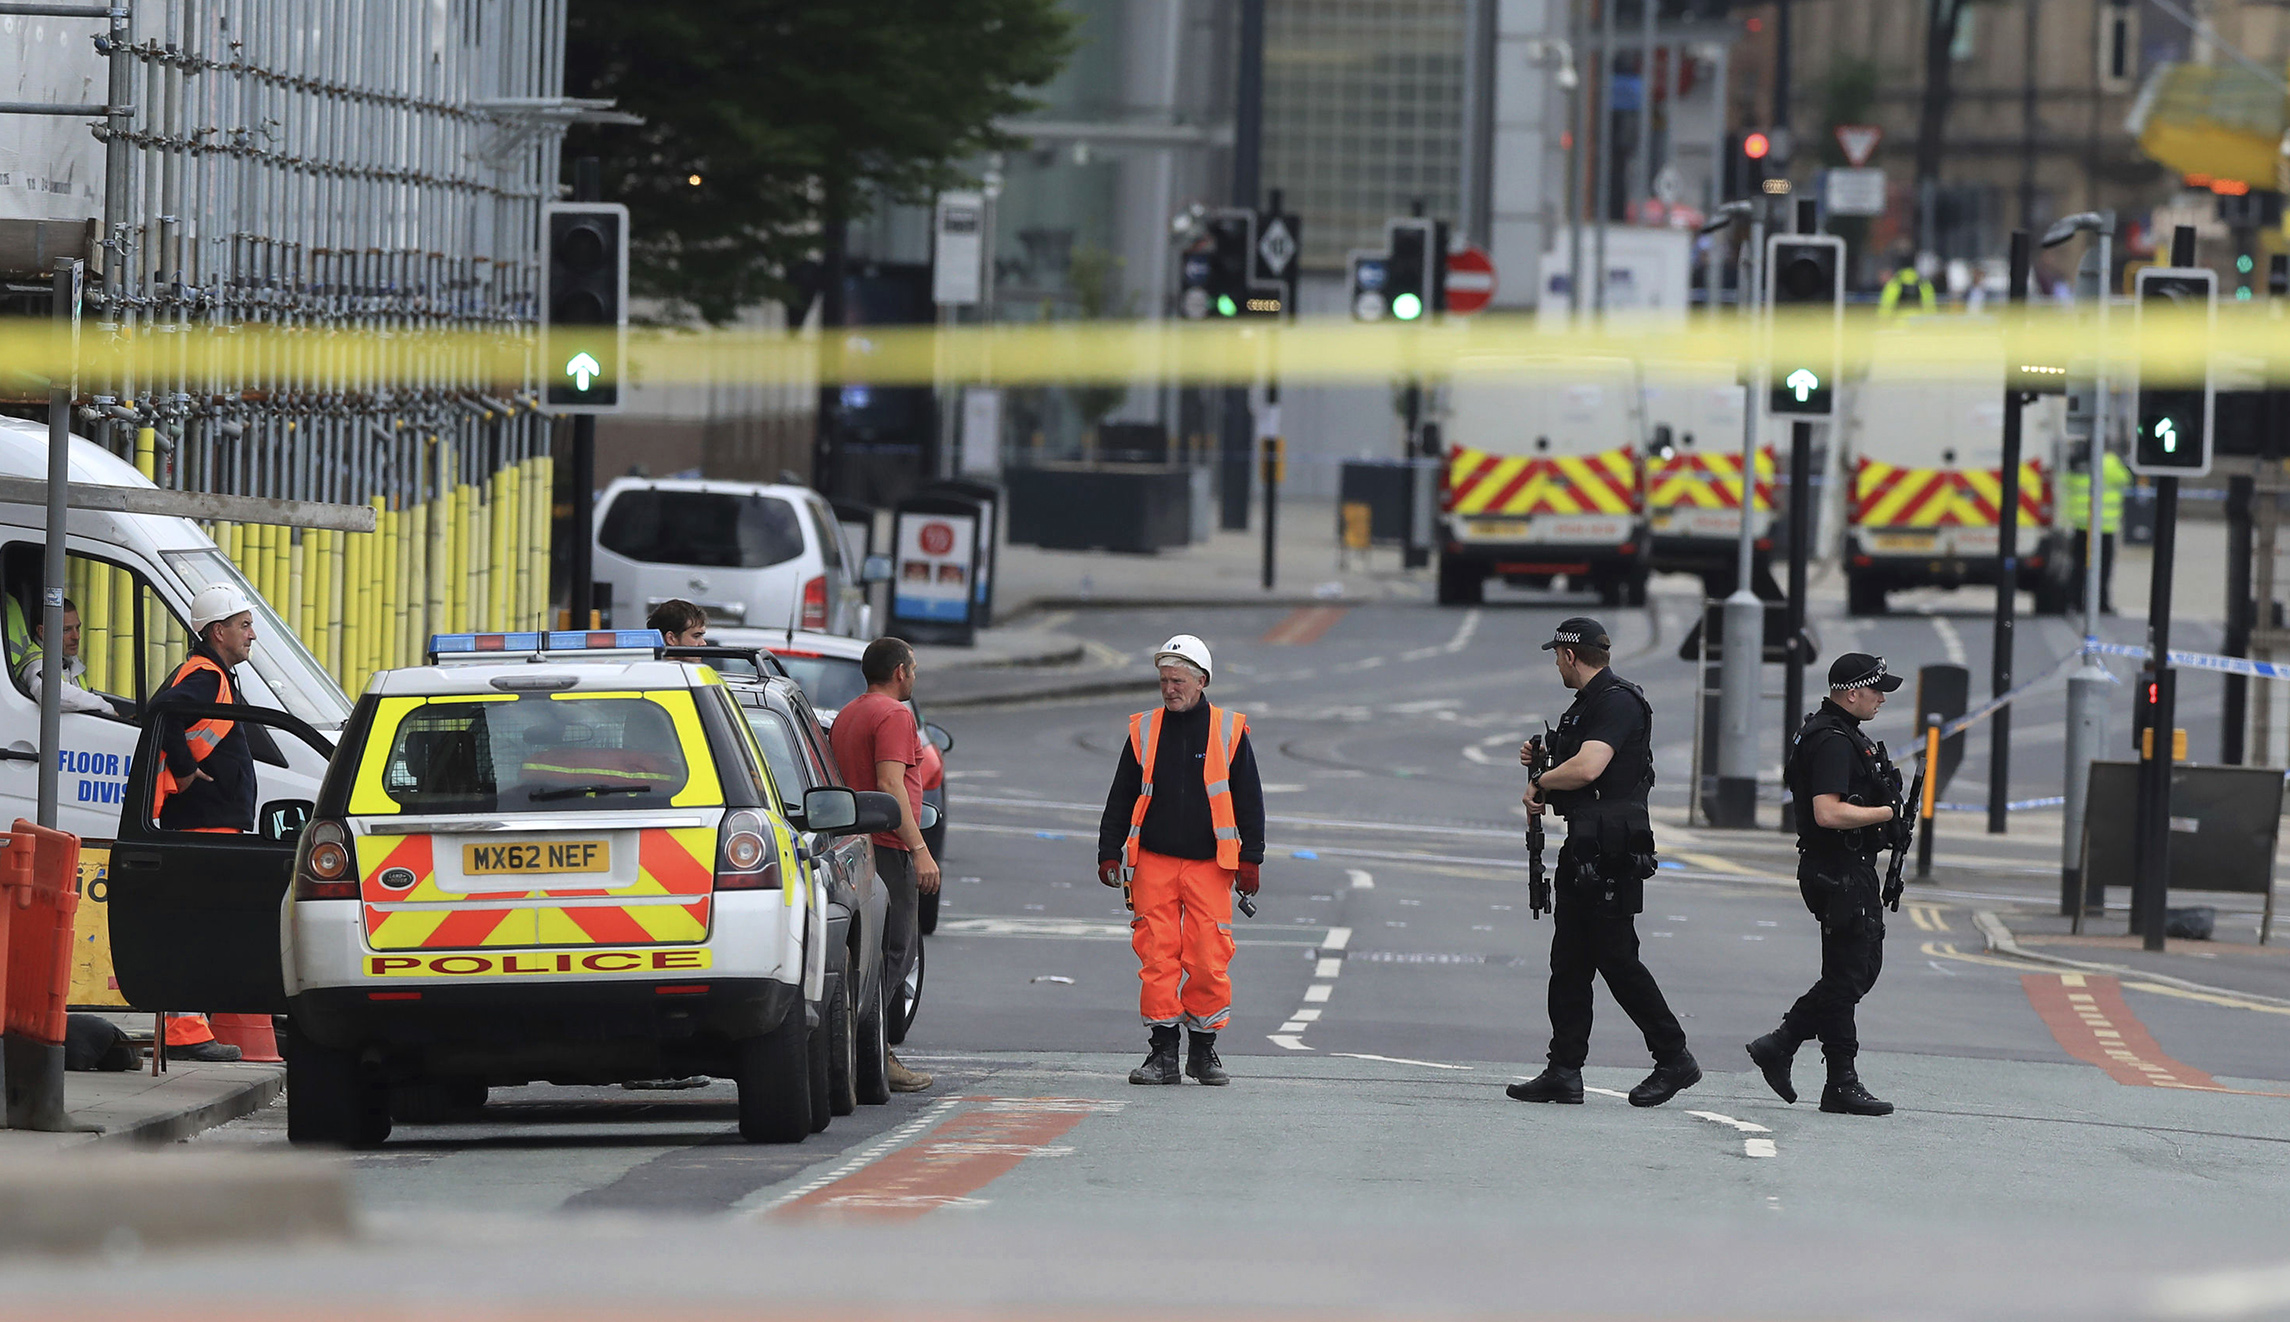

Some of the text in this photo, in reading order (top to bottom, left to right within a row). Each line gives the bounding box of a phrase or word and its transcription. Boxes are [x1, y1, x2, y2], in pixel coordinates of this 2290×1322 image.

[58, 750, 119, 776] FLOOR
[474, 844, 598, 870] MX62 NEF
[371, 950, 703, 975] POLICE
